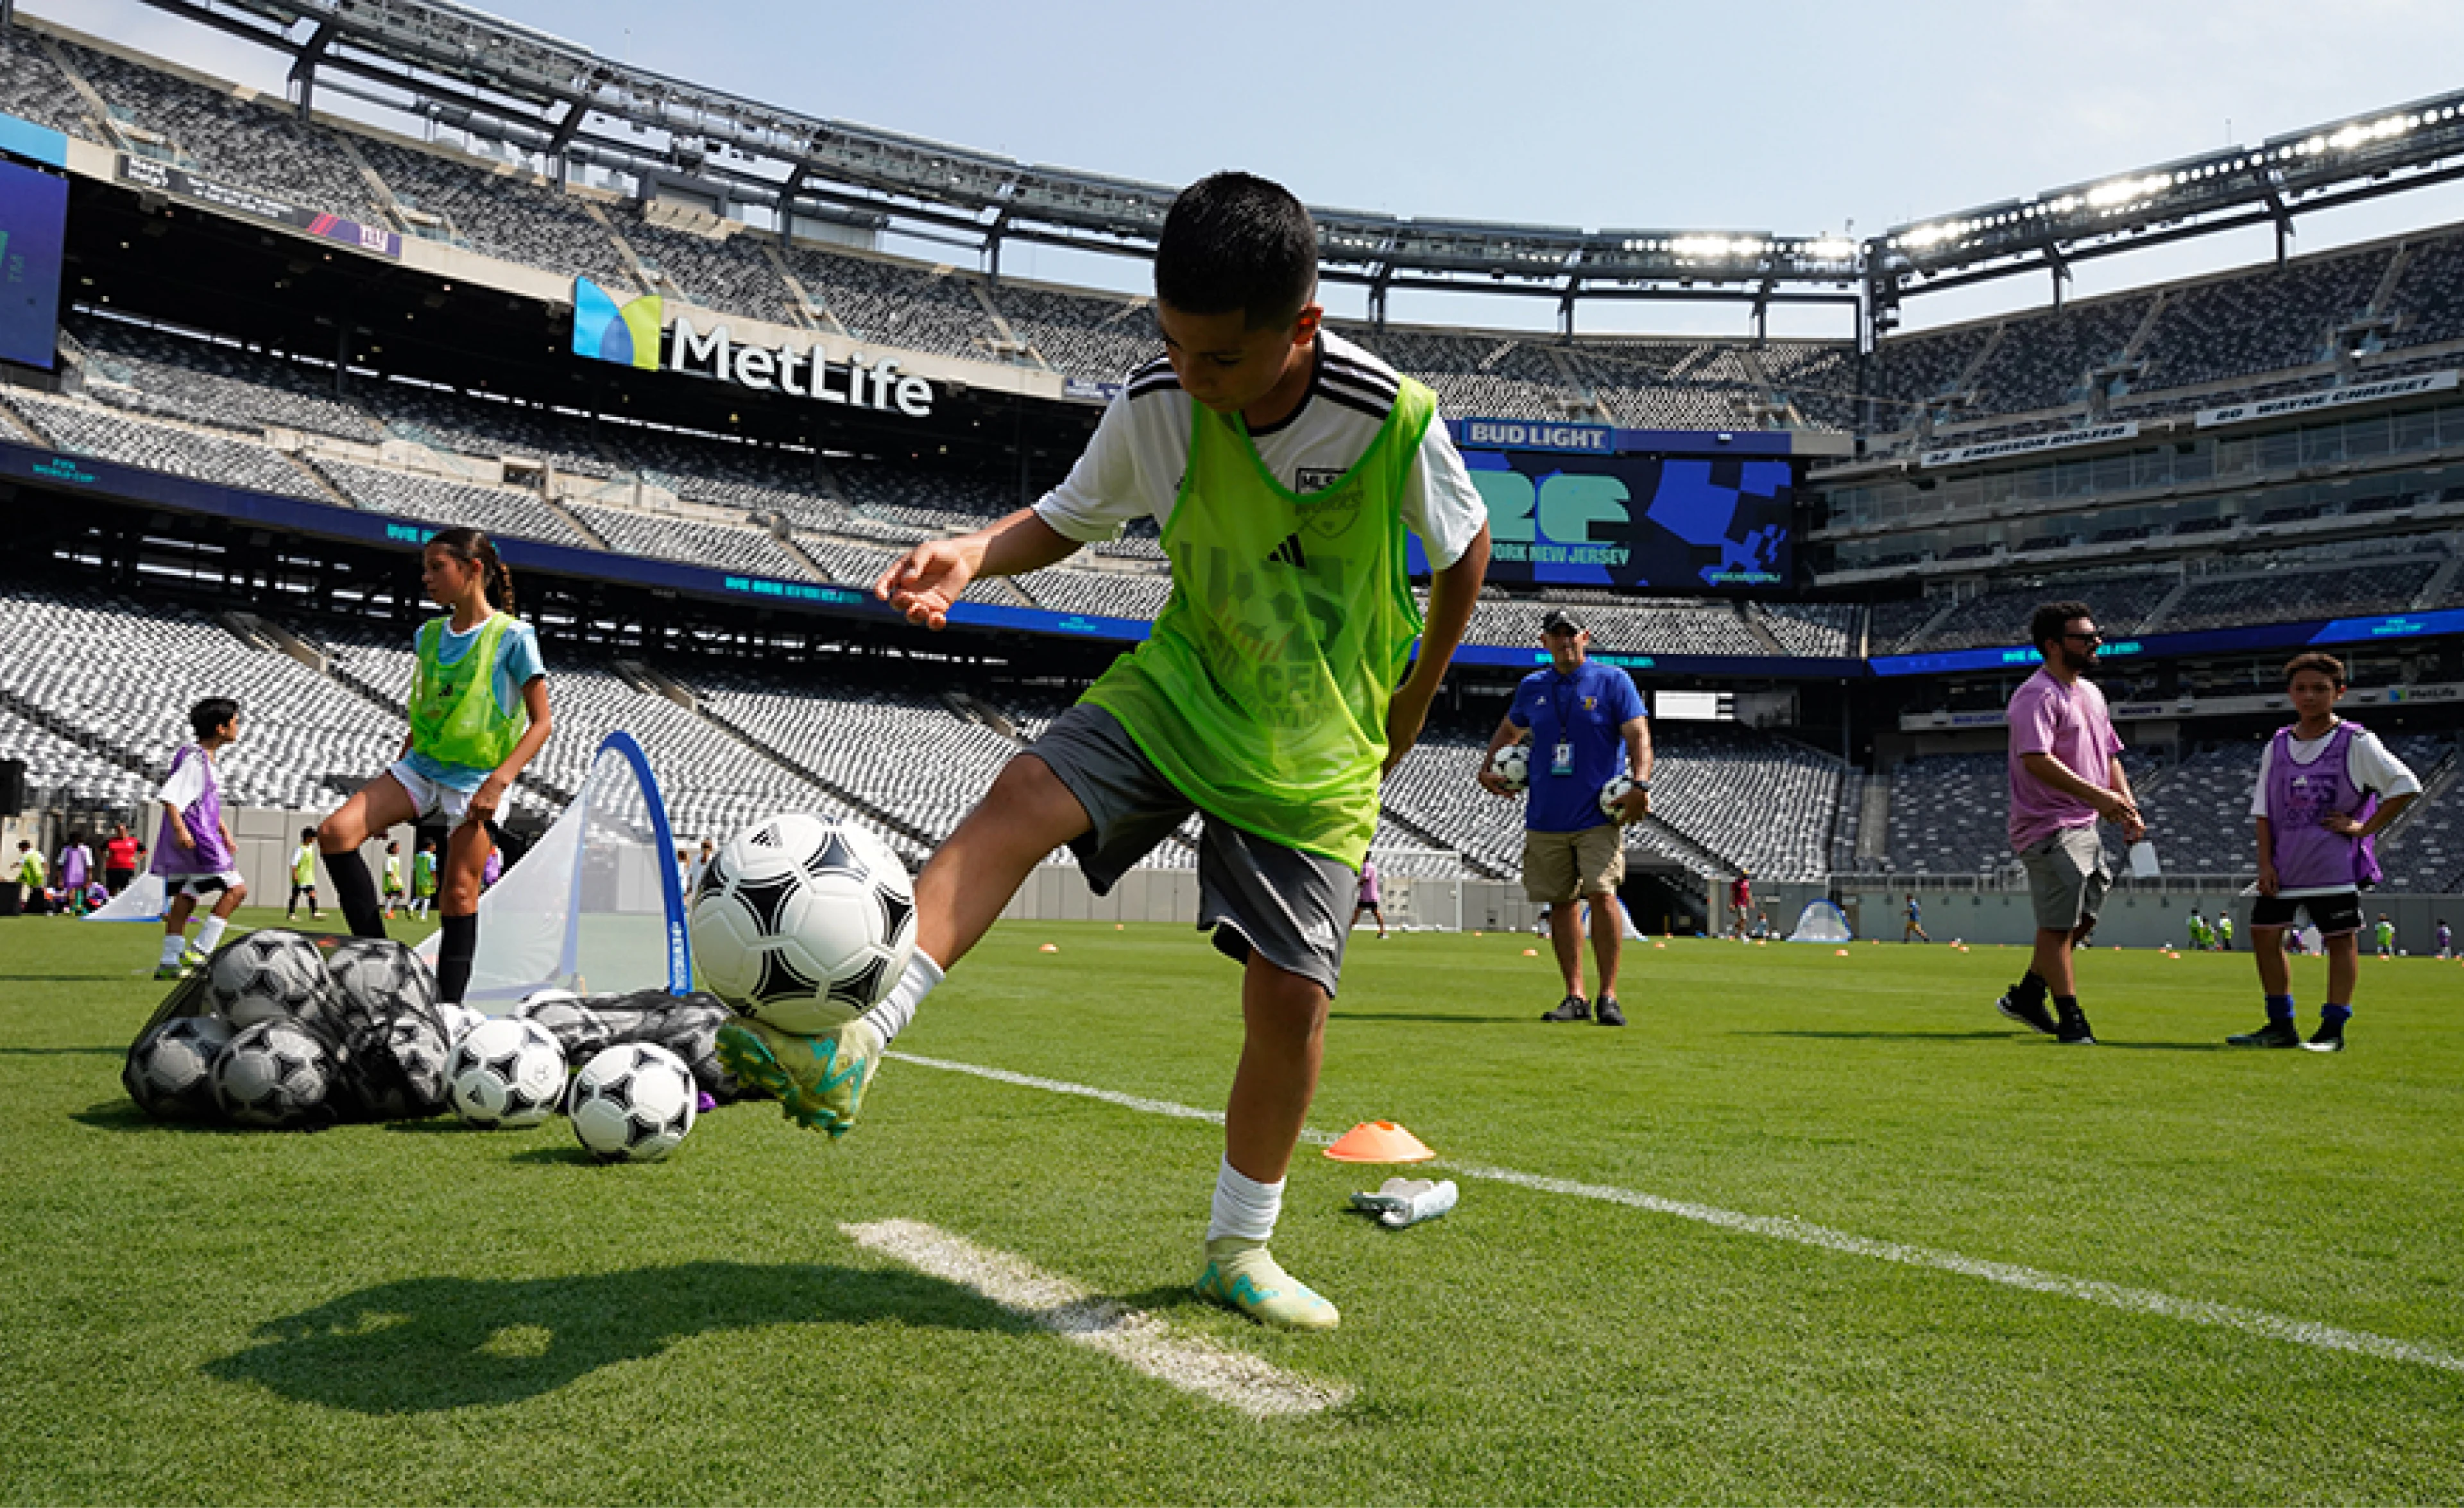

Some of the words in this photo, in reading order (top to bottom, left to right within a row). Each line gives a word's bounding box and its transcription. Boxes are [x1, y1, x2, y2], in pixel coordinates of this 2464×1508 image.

[671, 316, 933, 417] MetLife
[1471, 422, 1526, 443] BUD
[1529, 425, 1606, 449] LIGHT
[1529, 545, 1566, 563] NEW
[1568, 547, 1629, 566] JERSEY
